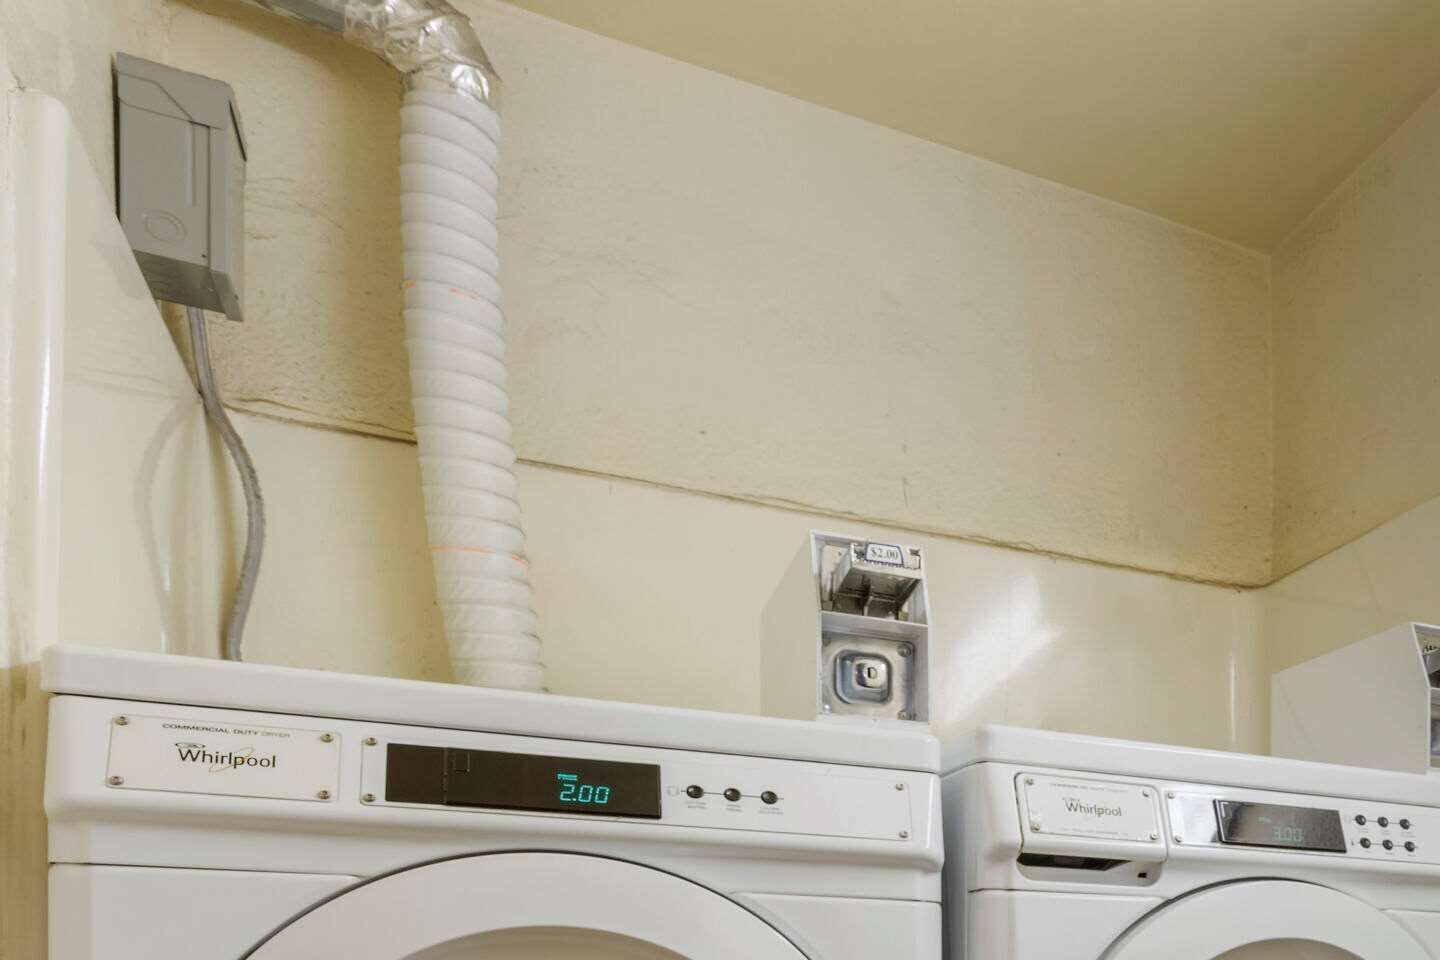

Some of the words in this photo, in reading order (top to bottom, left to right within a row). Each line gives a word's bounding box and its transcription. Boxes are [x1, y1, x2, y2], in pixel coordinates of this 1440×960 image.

[178, 747, 276, 769] Whirlpool
[560, 783, 609, 804] 2.00
[1065, 800, 1122, 817] Whirlpool
